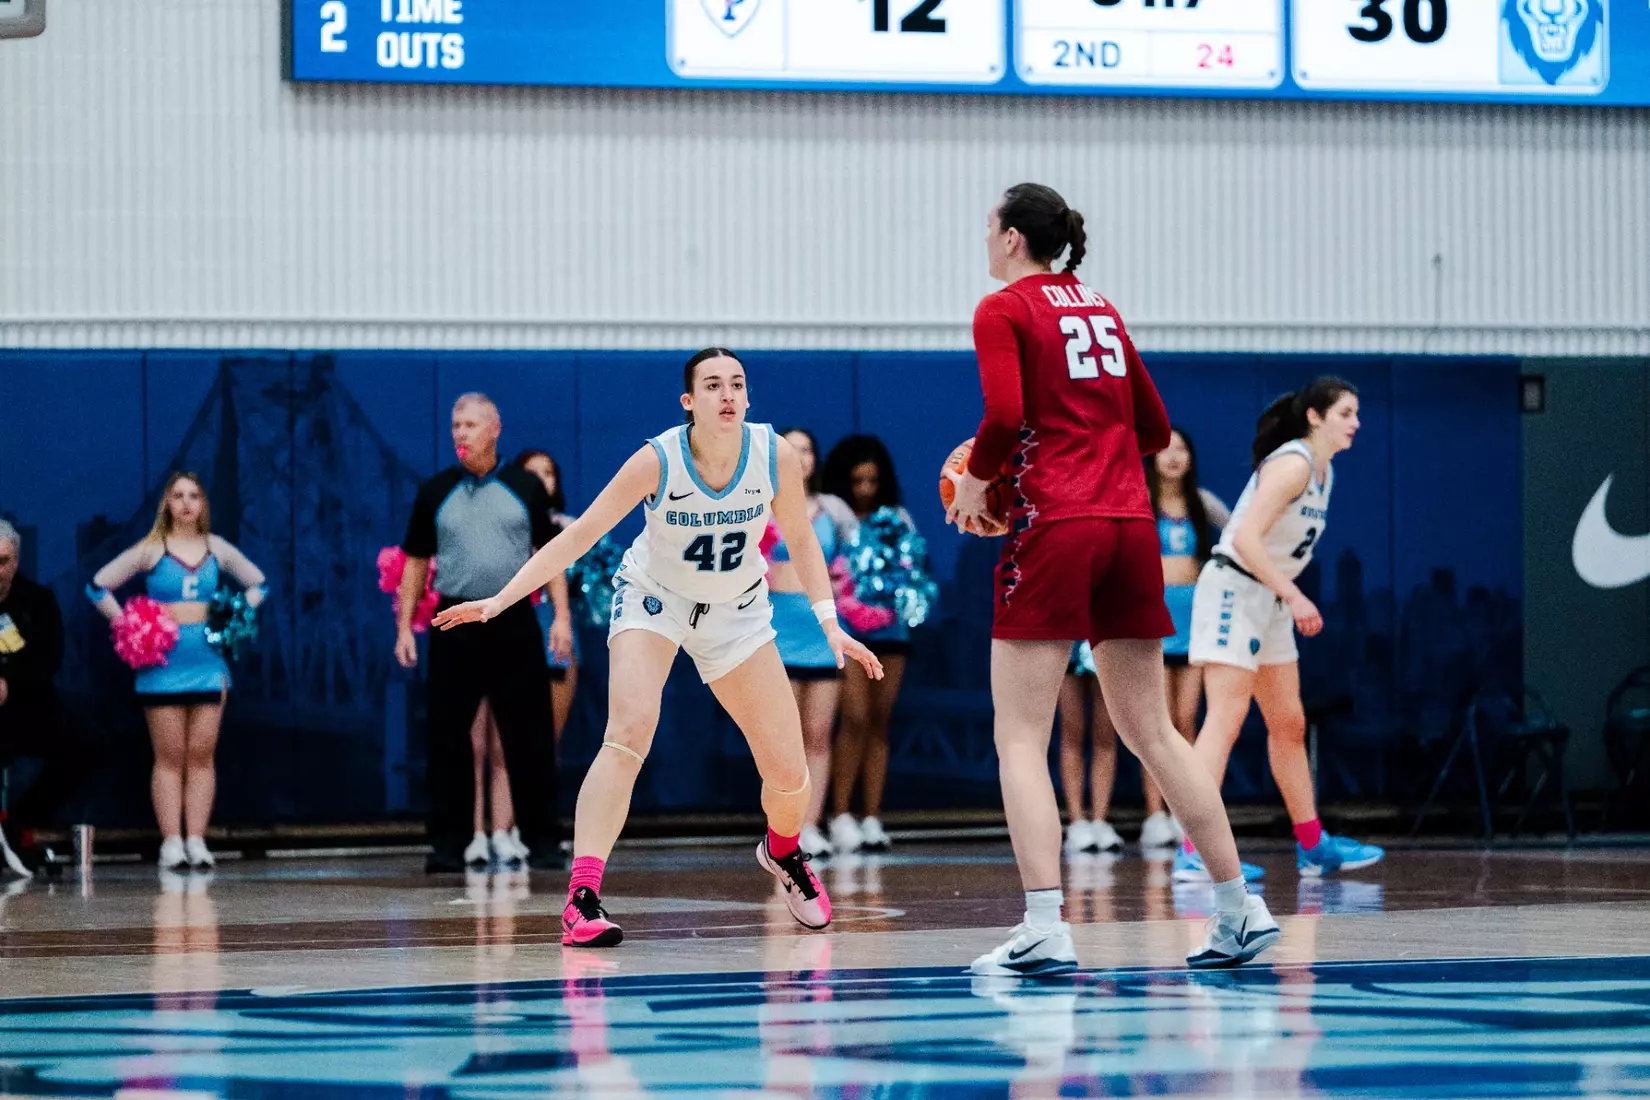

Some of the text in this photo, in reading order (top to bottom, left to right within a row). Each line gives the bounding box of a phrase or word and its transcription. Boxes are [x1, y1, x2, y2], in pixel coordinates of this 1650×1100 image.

[320, 0, 348, 53] 2
[380, 0, 464, 24] TIME
[1347, 0, 1448, 43] 30
[376, 31, 465, 69] OUTS
[1053, 40, 1122, 68] 2ND
[1197, 43, 1234, 69] 24
[1041, 284, 1106, 308] COLLINS
[1058, 314, 1127, 380] 25
[666, 504, 764, 527] COLUMBIA
[682, 531, 748, 573] 42
